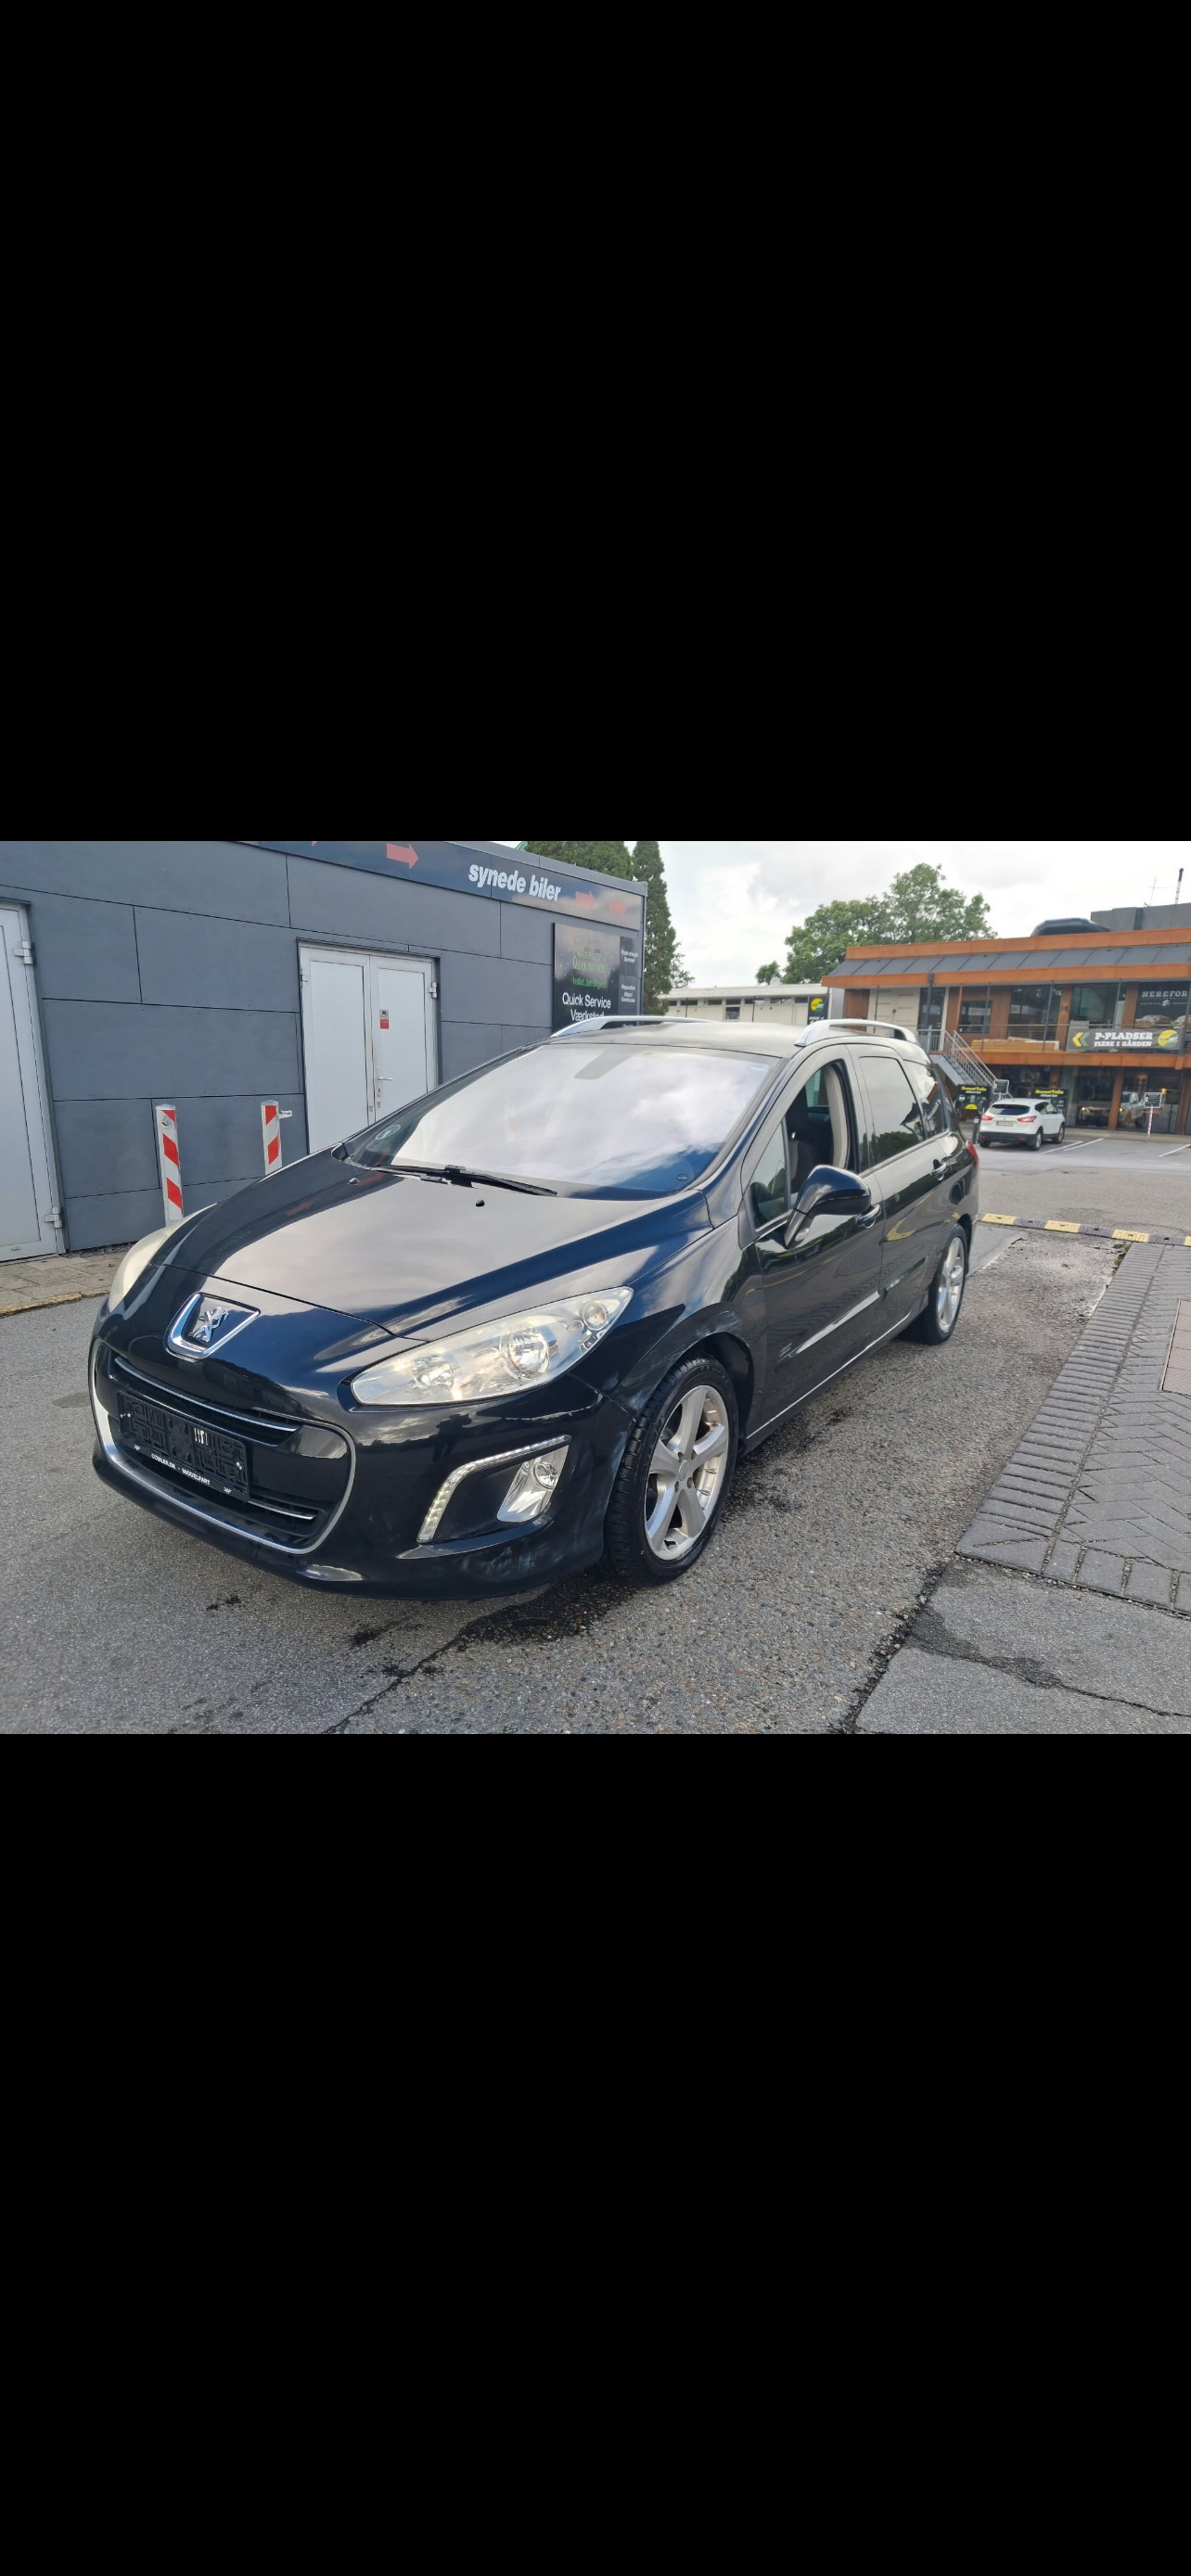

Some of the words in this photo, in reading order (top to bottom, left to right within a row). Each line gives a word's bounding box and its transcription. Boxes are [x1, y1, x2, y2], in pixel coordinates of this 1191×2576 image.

[468, 864, 525, 893] synede
[529, 874, 561, 901] biler
[562, 992, 583, 1006] Quick
[585, 994, 611, 1009] Service
[1121, 1039, 1153, 1047] GÅRDEN
